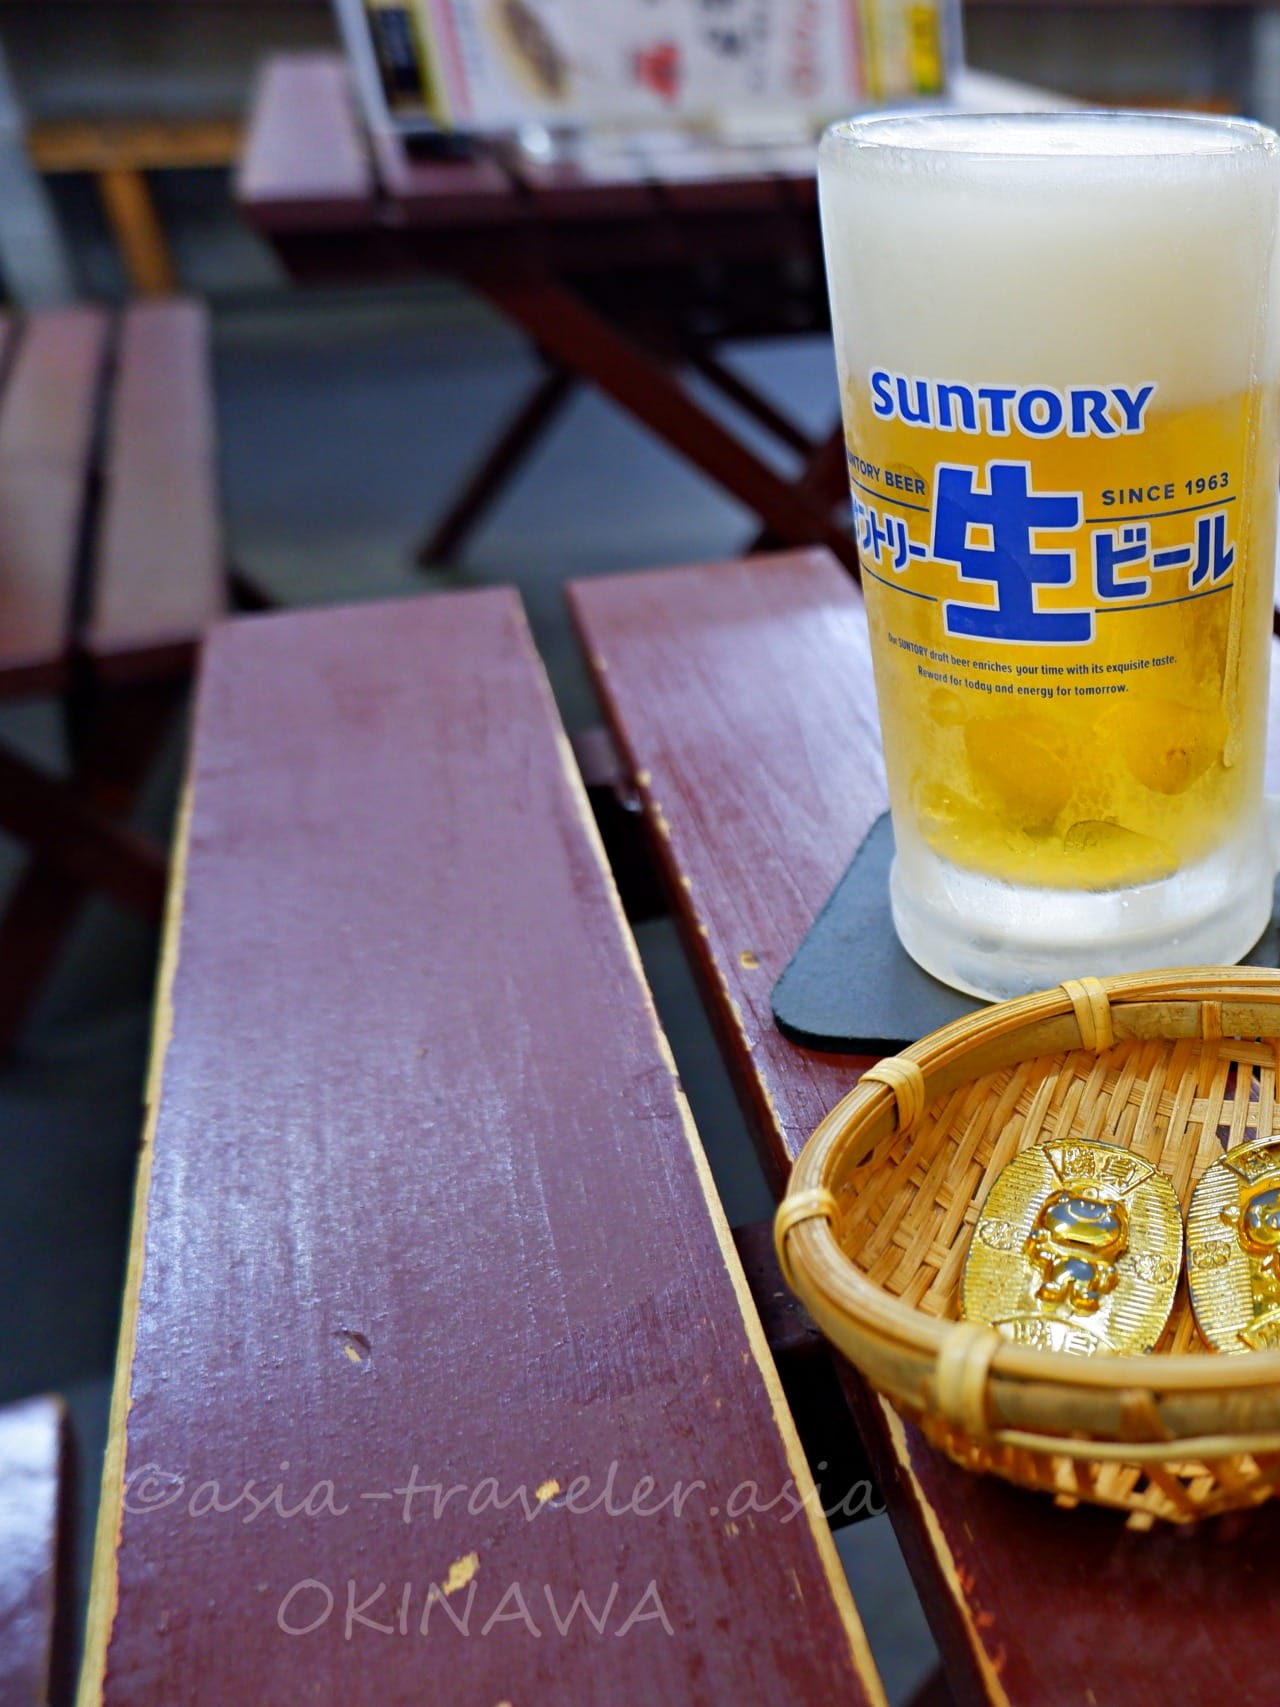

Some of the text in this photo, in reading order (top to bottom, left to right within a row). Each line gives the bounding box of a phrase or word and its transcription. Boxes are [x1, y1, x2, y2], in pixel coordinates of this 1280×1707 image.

[870, 369, 1156, 436] SUNTORY
[847, 453, 925, 496] NTORY BEER
[1102, 472, 1229, 506] SINCE 1963
[898, 638, 928, 657] SUNTORY
[930, 650, 949, 663] draft
[951, 655, 970, 668] beer
[973, 661, 1013, 674] enriches
[1016, 665, 1038, 677] your
[1041, 664, 1064, 675] time
[1066, 664, 1089, 675] with
[1091, 664, 1104, 674] its
[1106, 659, 1150, 674] exquisite
[1152, 655, 1178, 665] taste.
[918, 665, 1129, 698] Reward for today and energy for tomorrow.
